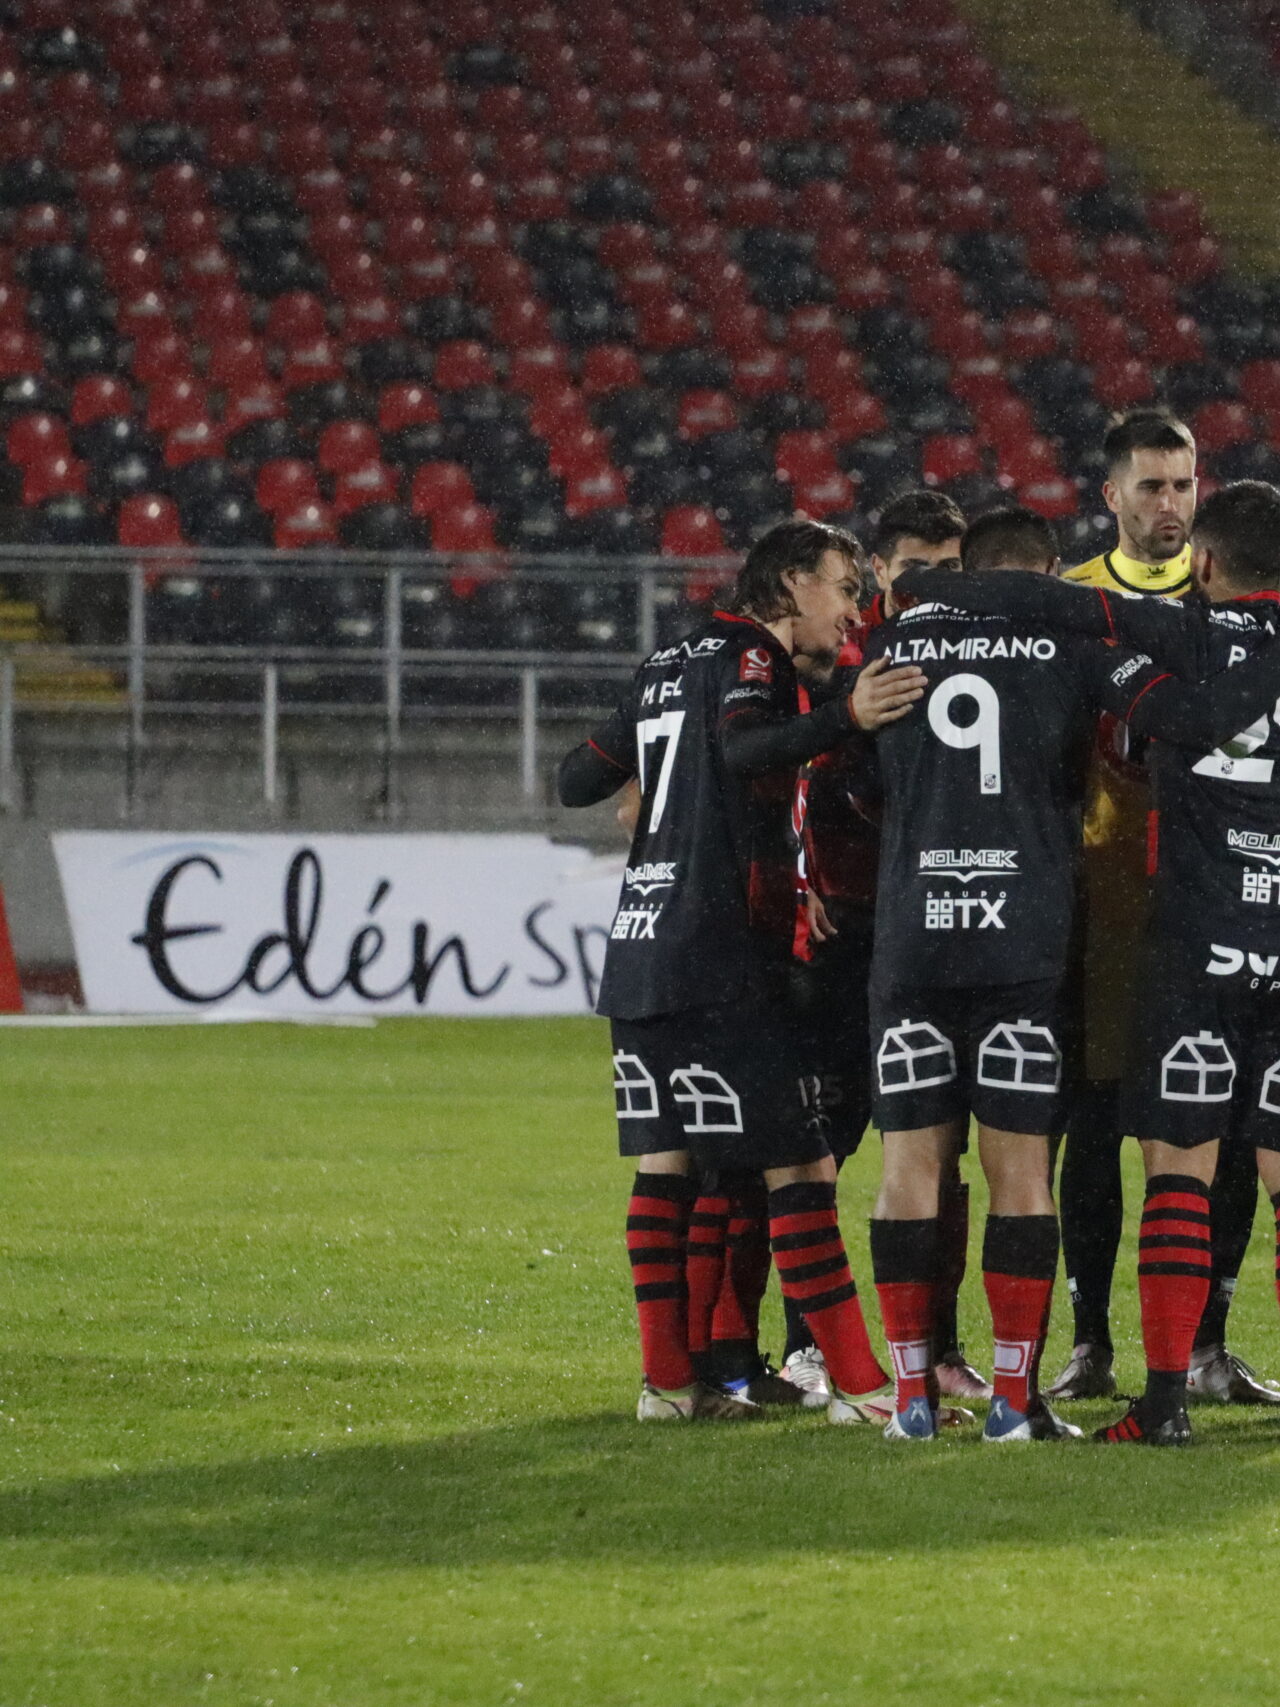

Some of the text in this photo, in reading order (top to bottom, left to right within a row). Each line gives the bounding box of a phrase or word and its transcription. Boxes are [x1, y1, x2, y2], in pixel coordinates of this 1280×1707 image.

[884, 635, 1056, 666] ALTAMIRANO
[927, 673, 1002, 795] 9
[919, 849, 1019, 869] MOLIMEK
[926, 890, 1007, 899] GRUPO
[131, 847, 511, 1005] Edén
